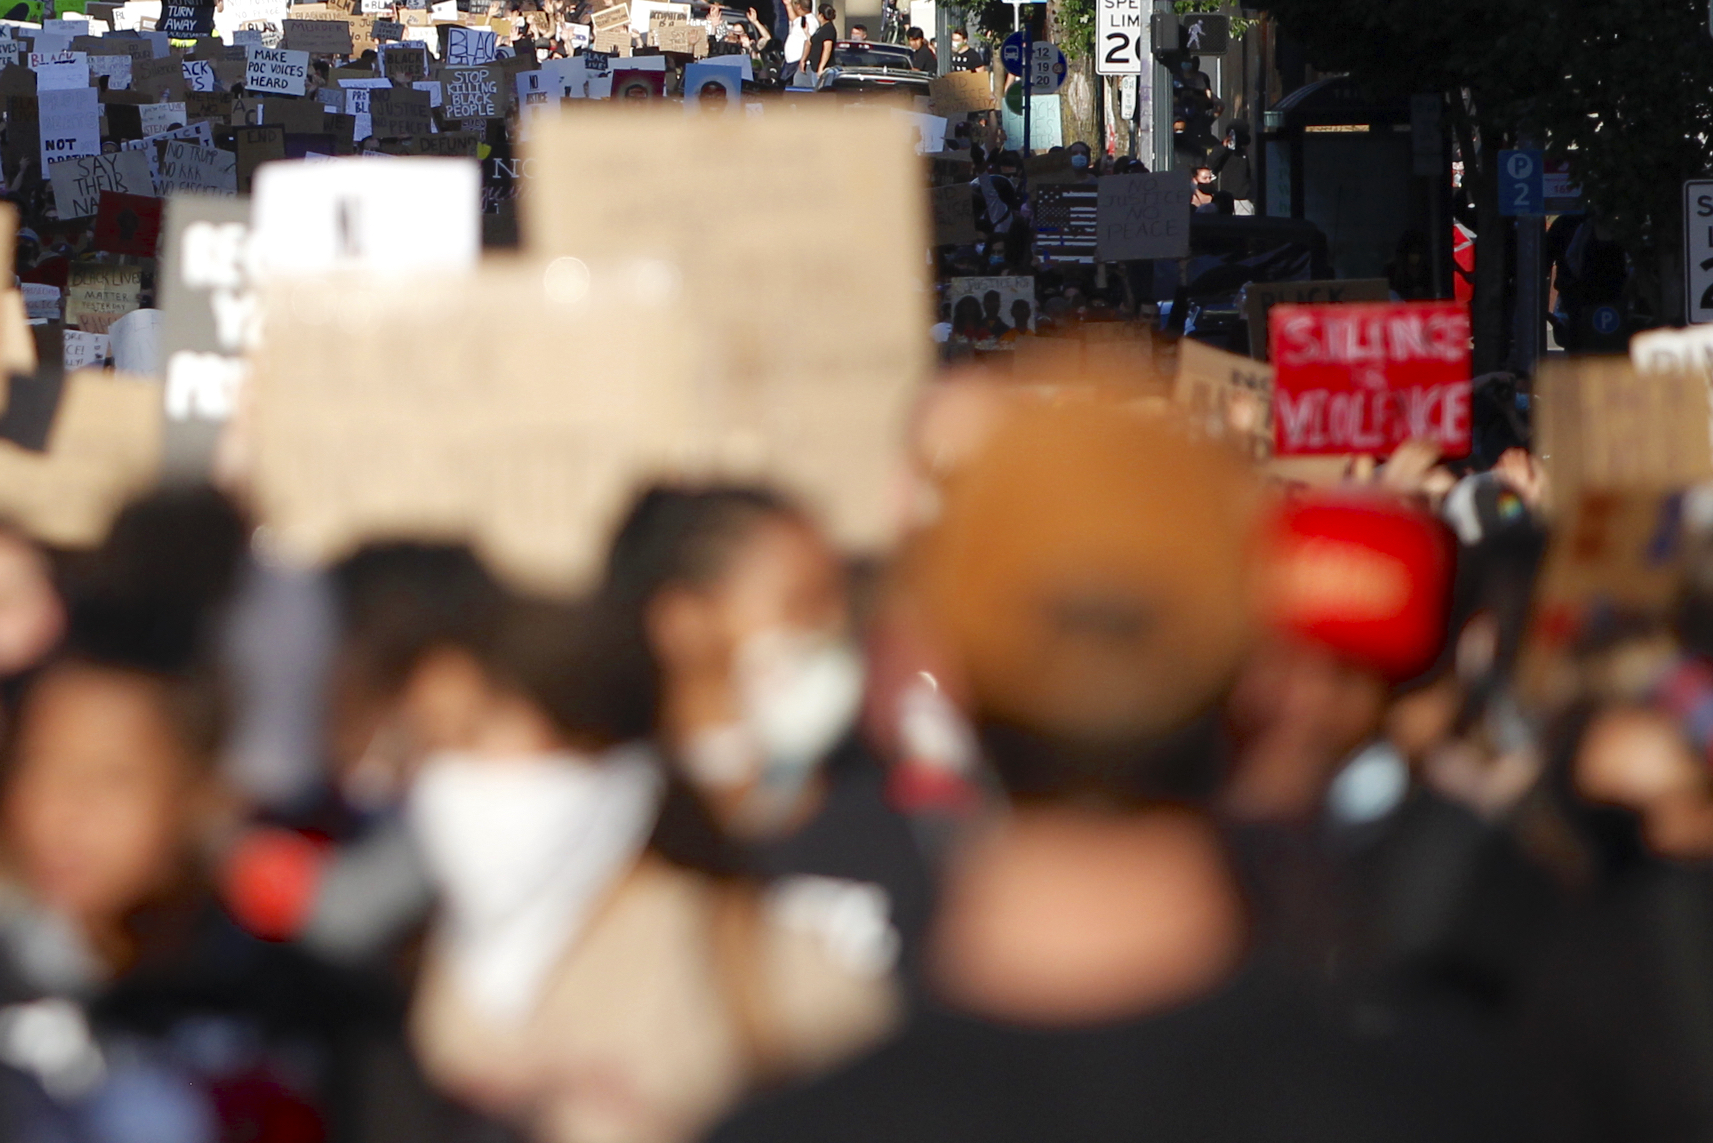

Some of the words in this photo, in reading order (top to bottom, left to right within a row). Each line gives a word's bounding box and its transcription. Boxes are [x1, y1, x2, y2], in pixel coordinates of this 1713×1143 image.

[168, 6, 195, 17] TURN
[164, 18, 197, 31] AWAY
[1110, 14, 1140, 27] LIM
[254, 50, 287, 63] MAKE
[1036, 47, 1049, 57] 12
[248, 61, 267, 73] POC
[271, 64, 304, 77] VOICES
[1036, 63, 1049, 72] 19
[251, 76, 288, 89] HEARD
[454, 70, 490, 84] STOP
[1036, 76, 1050, 85] 20
[447, 81, 498, 96] KILLING
[452, 93, 492, 106] BLACK
[377, 102, 429, 118] JUSTICE
[446, 104, 495, 118] PEOPLE
[247, 130, 277, 144] END
[45, 138, 77, 151] NOT
[166, 142, 184, 158] NO
[189, 145, 219, 165] TRUMP
[77, 155, 120, 178] SAY
[163, 162, 178, 178] NO
[178, 165, 202, 181] KKK
[72, 171, 129, 197] THEIR
[1127, 178, 1158, 192] NO
[1107, 189, 1187, 208] JUSTICE
[1513, 182, 1530, 206] 2
[1126, 206, 1159, 220] NO
[1107, 220, 1177, 240] PEACE
[84, 290, 128, 302] MATTER
[1601, 311, 1613, 329] P
